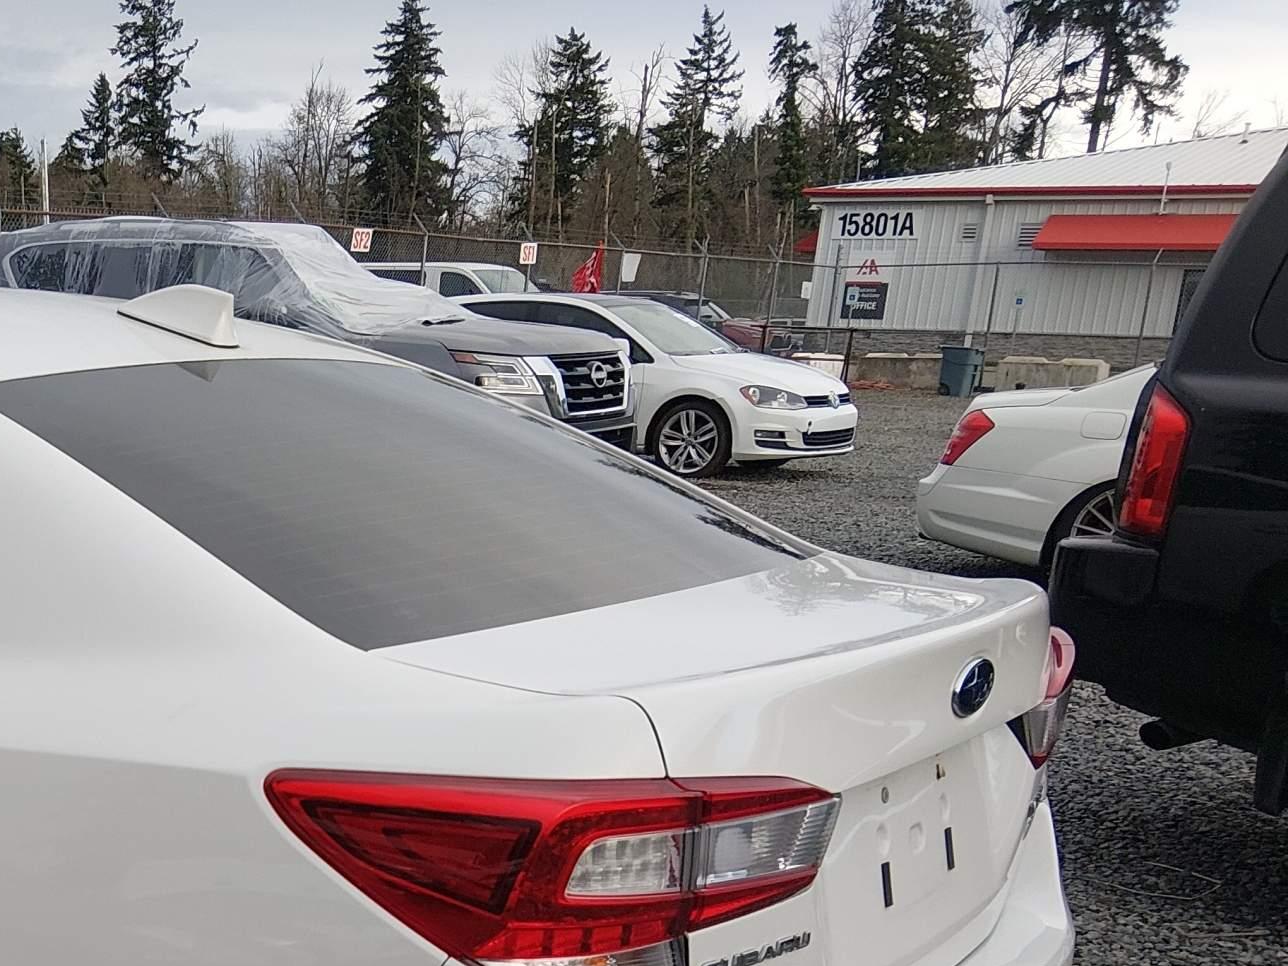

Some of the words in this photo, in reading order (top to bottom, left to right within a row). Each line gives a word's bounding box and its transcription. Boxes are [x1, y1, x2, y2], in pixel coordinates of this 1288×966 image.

[838, 212, 914, 237] 15801A
[352, 228, 370, 250] SF2
[522, 245, 536, 263] SF1
